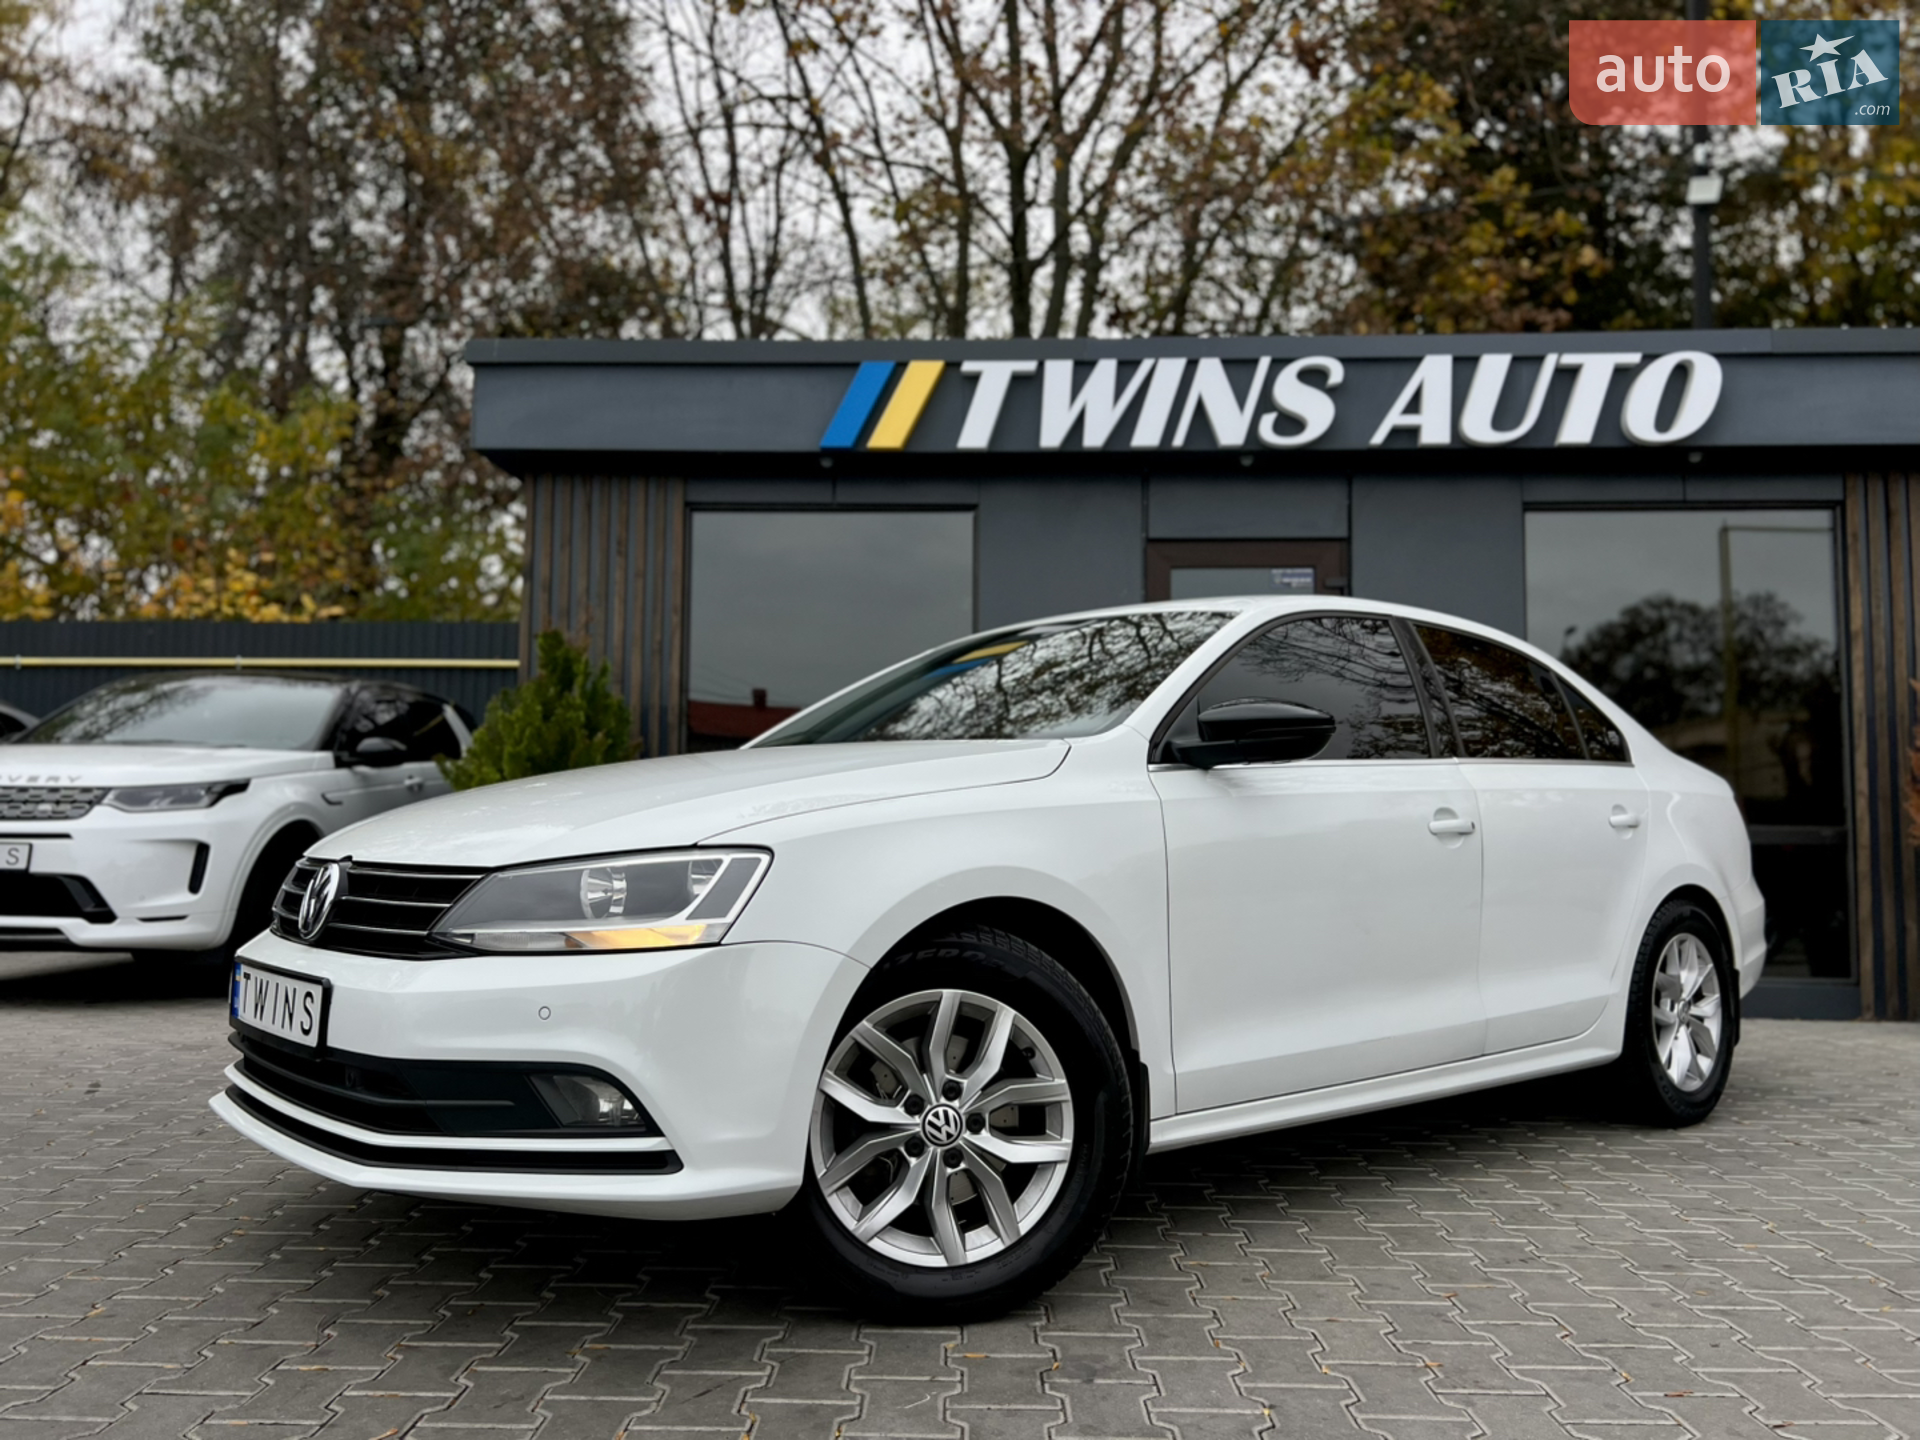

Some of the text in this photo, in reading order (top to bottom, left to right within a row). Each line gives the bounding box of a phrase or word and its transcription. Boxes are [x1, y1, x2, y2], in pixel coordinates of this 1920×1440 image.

[956, 350, 1724, 450] TWINS AUTO
[0, 775, 82, 783] VERY
[243, 971, 315, 1037] TWINS
